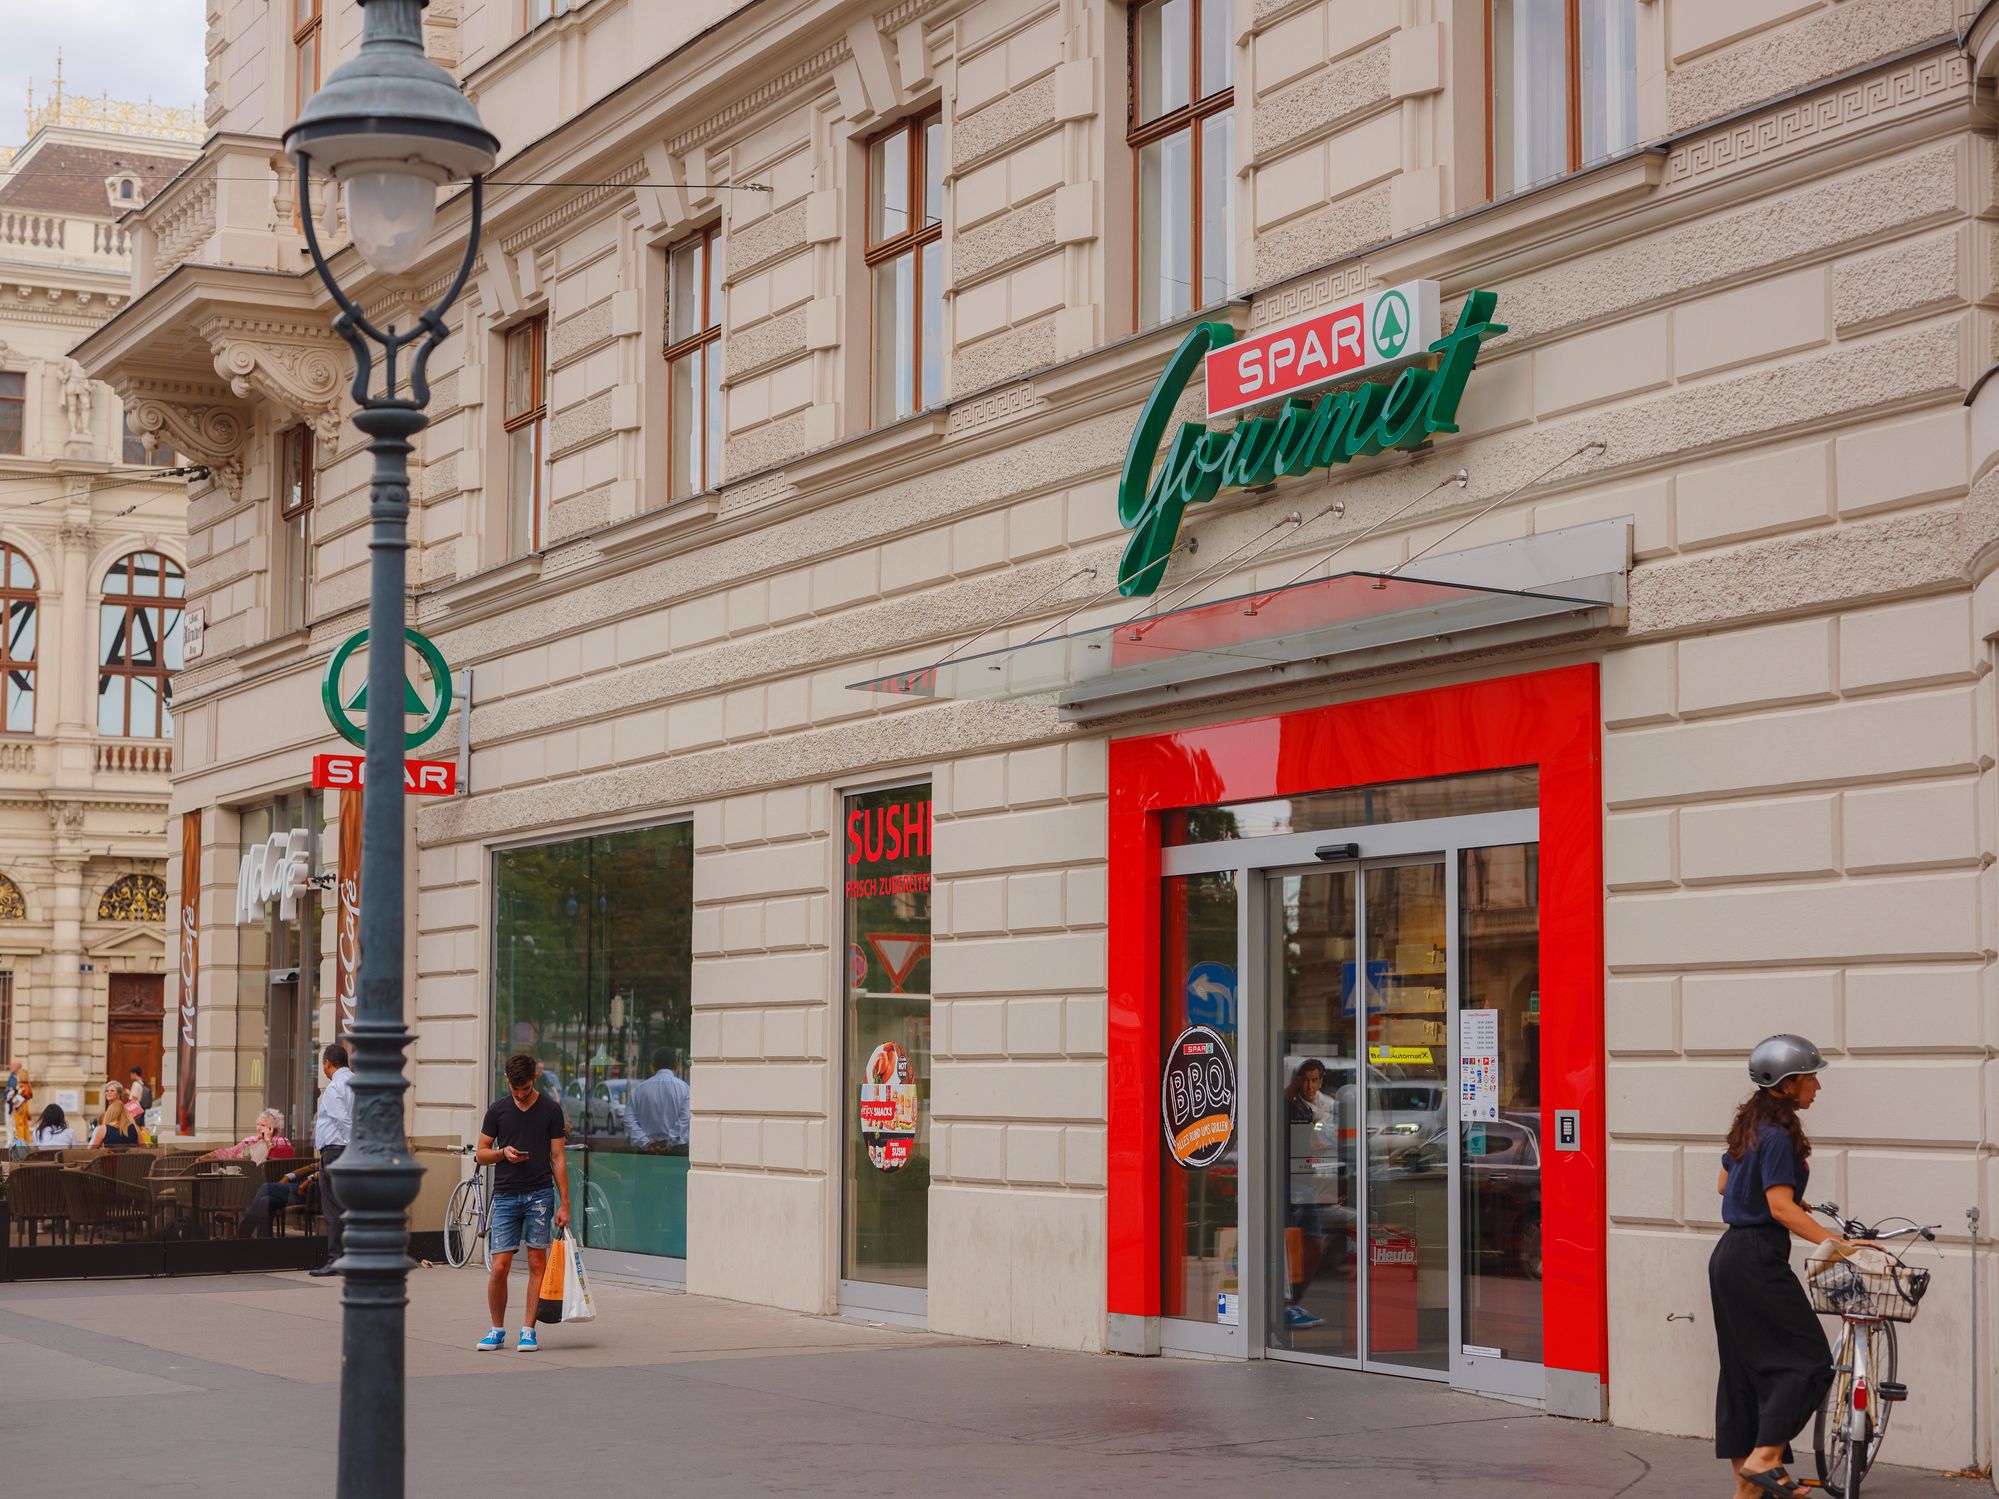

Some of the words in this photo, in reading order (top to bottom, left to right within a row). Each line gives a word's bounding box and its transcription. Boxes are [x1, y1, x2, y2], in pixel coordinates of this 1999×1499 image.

[1238, 314, 1362, 395] SPAR
[1117, 288, 1509, 597] Gourmet
[847, 799, 932, 865] SUSHI
[846, 879, 877, 899] FRISCH
[182, 904, 198, 1047] McCafé
[1187, 1045, 1206, 1053] SPAR
[1170, 1057, 1231, 1125] BBQ
[874, 1106, 893, 1117] SNACKS
[891, 1147, 907, 1157] SUSHI
[1177, 1133, 1190, 1152] ALLES
[1376, 1247, 1414, 1262] Heute
